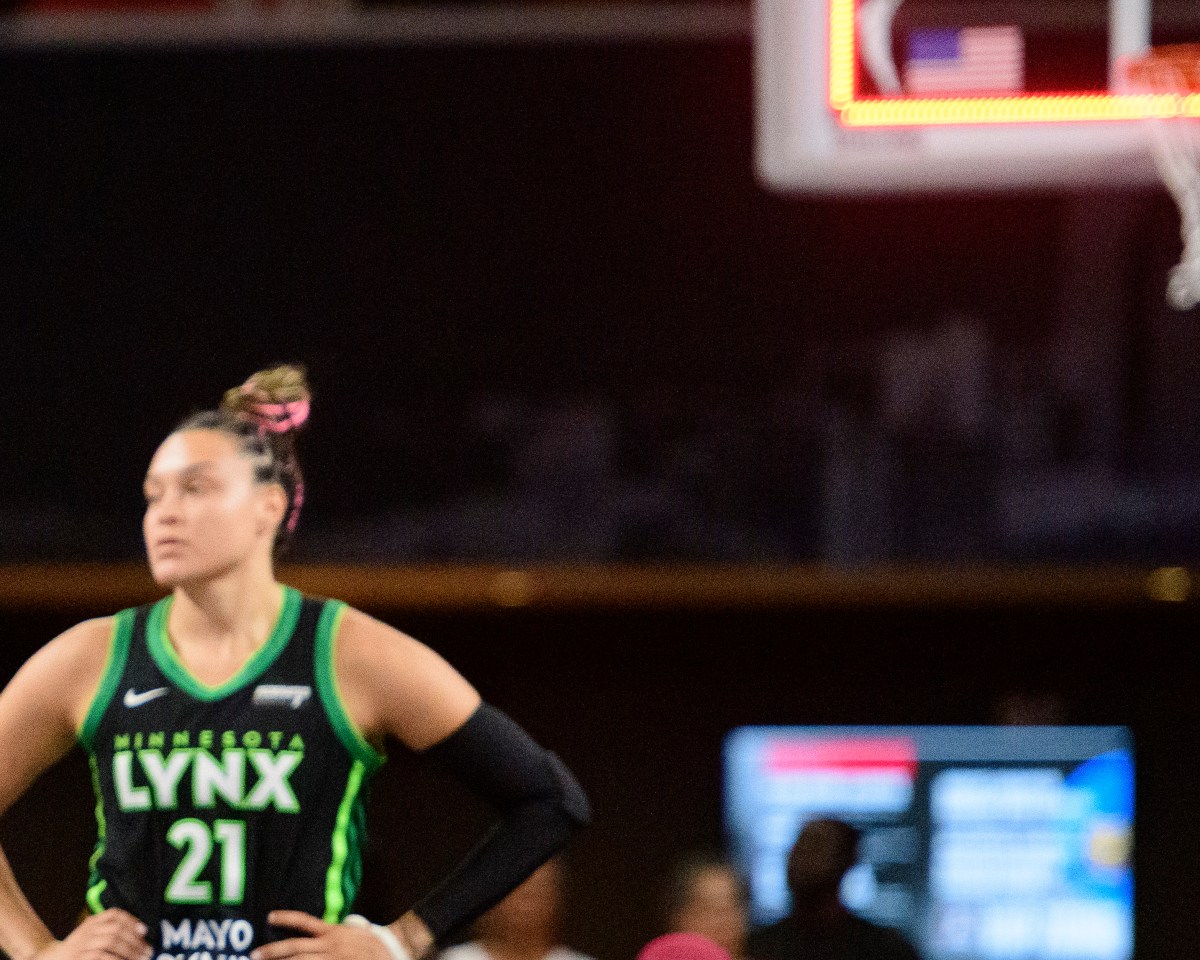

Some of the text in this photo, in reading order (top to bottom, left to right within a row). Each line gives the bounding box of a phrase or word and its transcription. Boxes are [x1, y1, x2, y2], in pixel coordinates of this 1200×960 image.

[113, 730, 305, 751] MINNESOTA
[112, 748, 304, 814] LYNX
[164, 817, 246, 905] 21
[161, 918, 254, 952] MAYO
